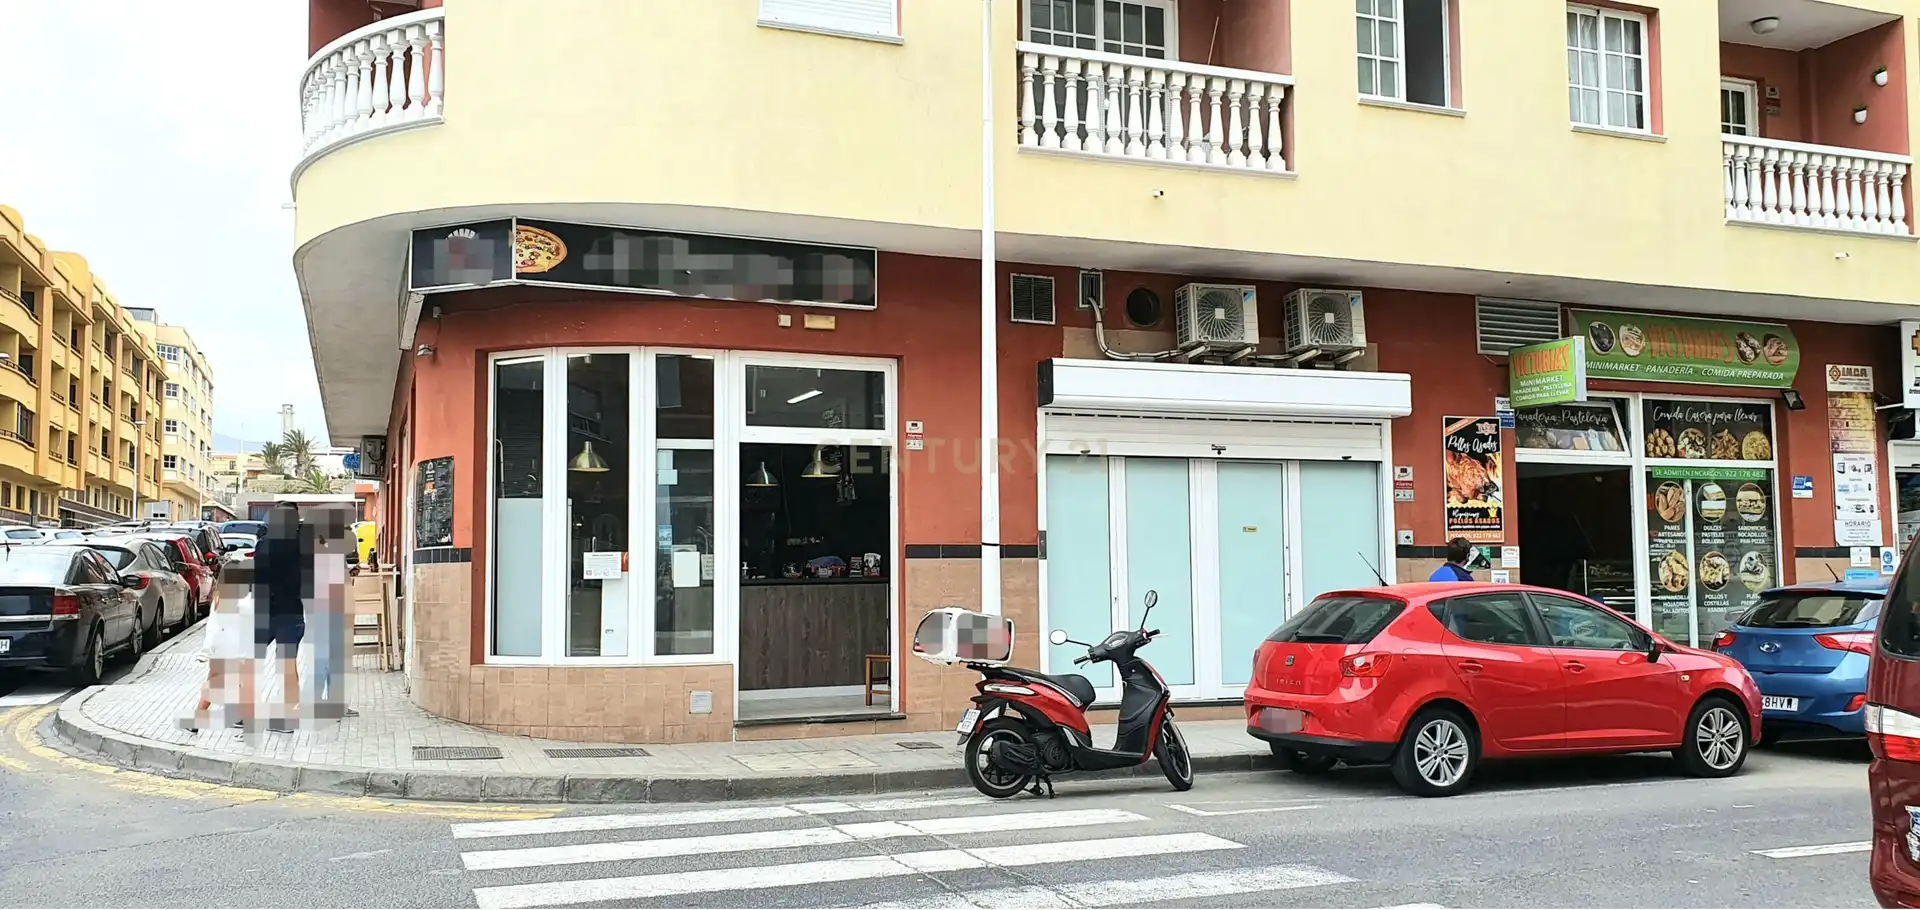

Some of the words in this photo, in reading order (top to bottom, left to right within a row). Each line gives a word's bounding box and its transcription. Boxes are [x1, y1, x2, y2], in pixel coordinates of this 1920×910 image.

[1513, 343, 1569, 379] VICTORIA'S
[1585, 361, 1640, 372] MINIMARKET
[1645, 364, 1693, 375] PANADERÍA
[1701, 368, 1735, 377] COMIDA
[1736, 370, 1784, 380] PREPARADA
[1520, 375, 1564, 387] MINIMARKET
[1515, 393, 1536, 401] COMIDA
